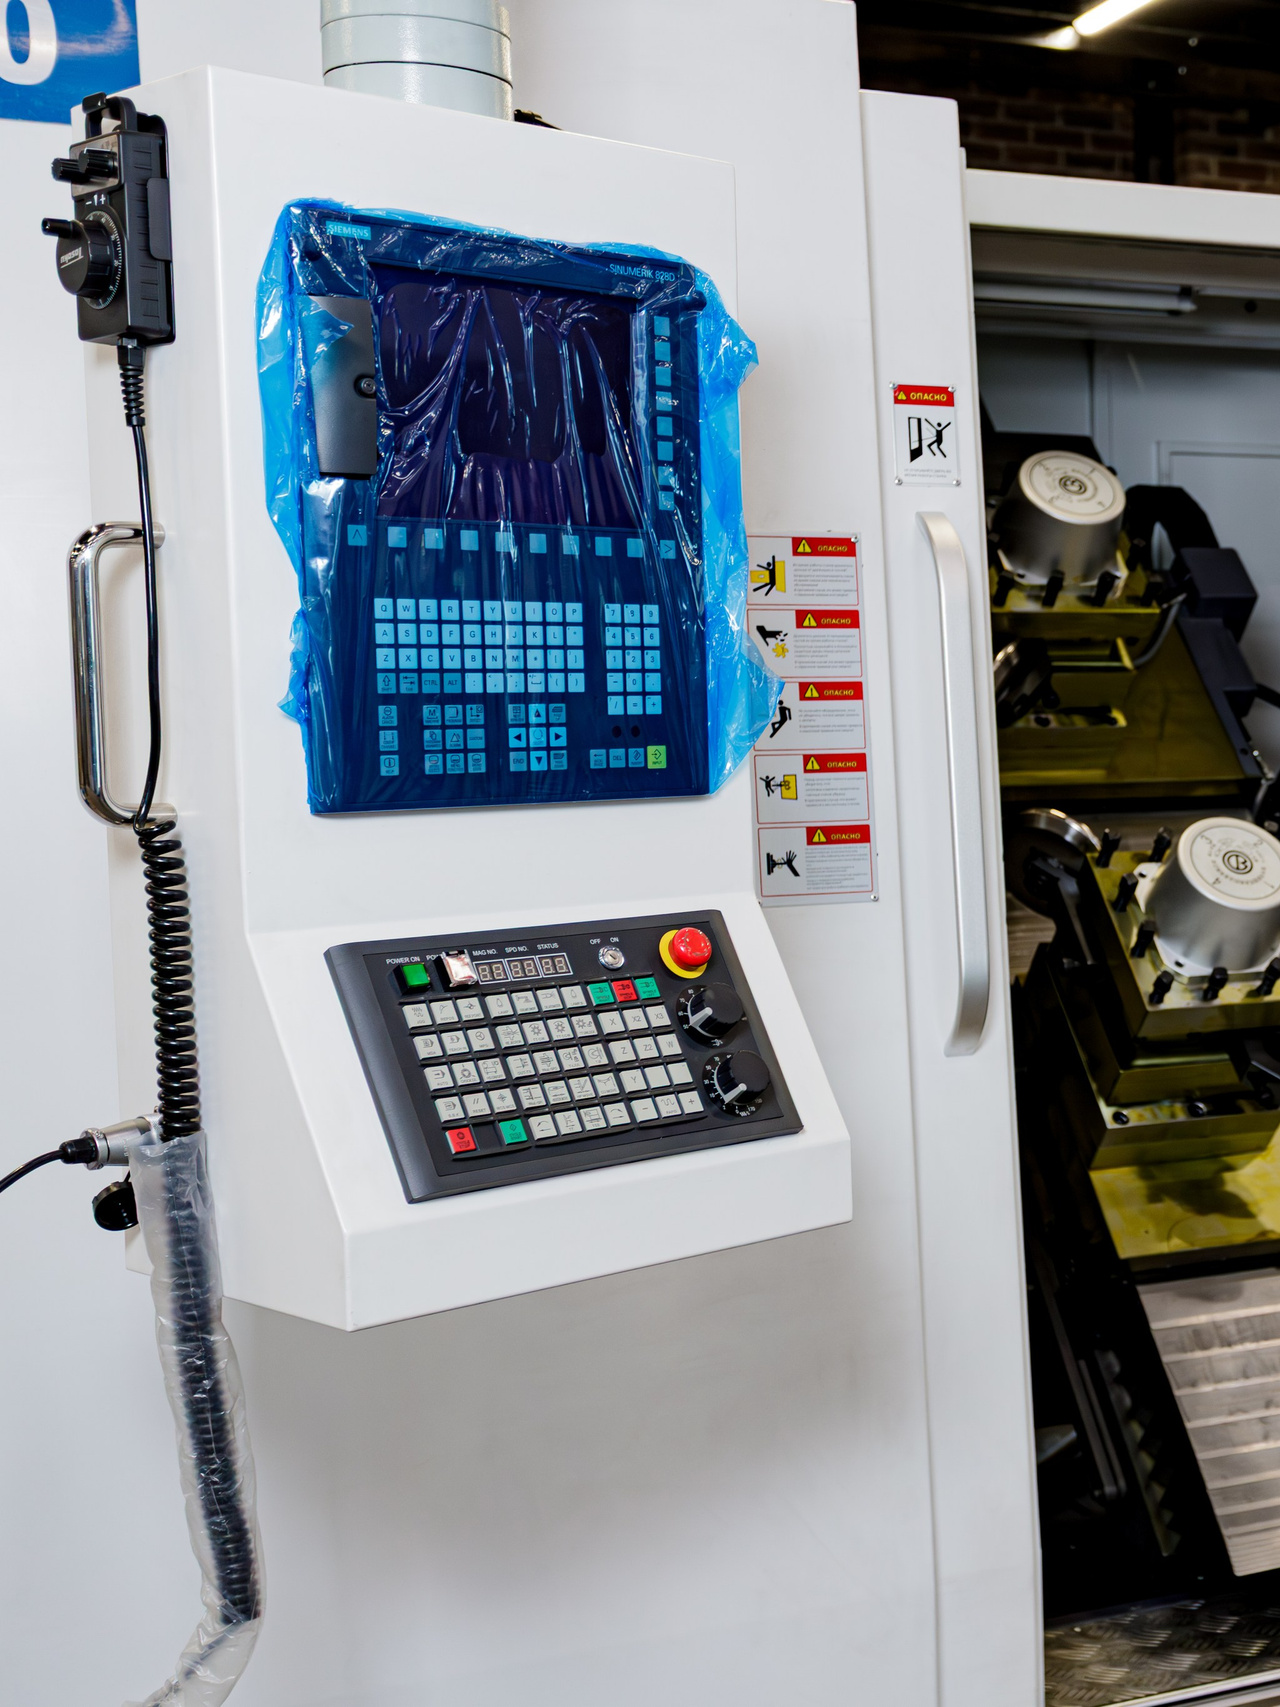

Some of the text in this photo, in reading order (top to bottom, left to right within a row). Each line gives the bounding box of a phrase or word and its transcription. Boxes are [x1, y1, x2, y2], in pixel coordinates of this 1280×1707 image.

[328, 224, 369, 238] SIEMENS
[609, 263, 675, 282] SINUMERIK 828D
[910, 392, 947, 402] ОПАСНО
[824, 688, 854, 696] ОПАСНО
[826, 760, 858, 768] ОПАСНО
[830, 832, 861, 840] ОПАСНО
[536, 942, 559, 950] STATUS
[386, 956, 409, 965] POWER
[620, 1046, 628, 1055] Z
[642, 1043, 653, 1052] Z2
[630, 1076, 637, 1084] Y
